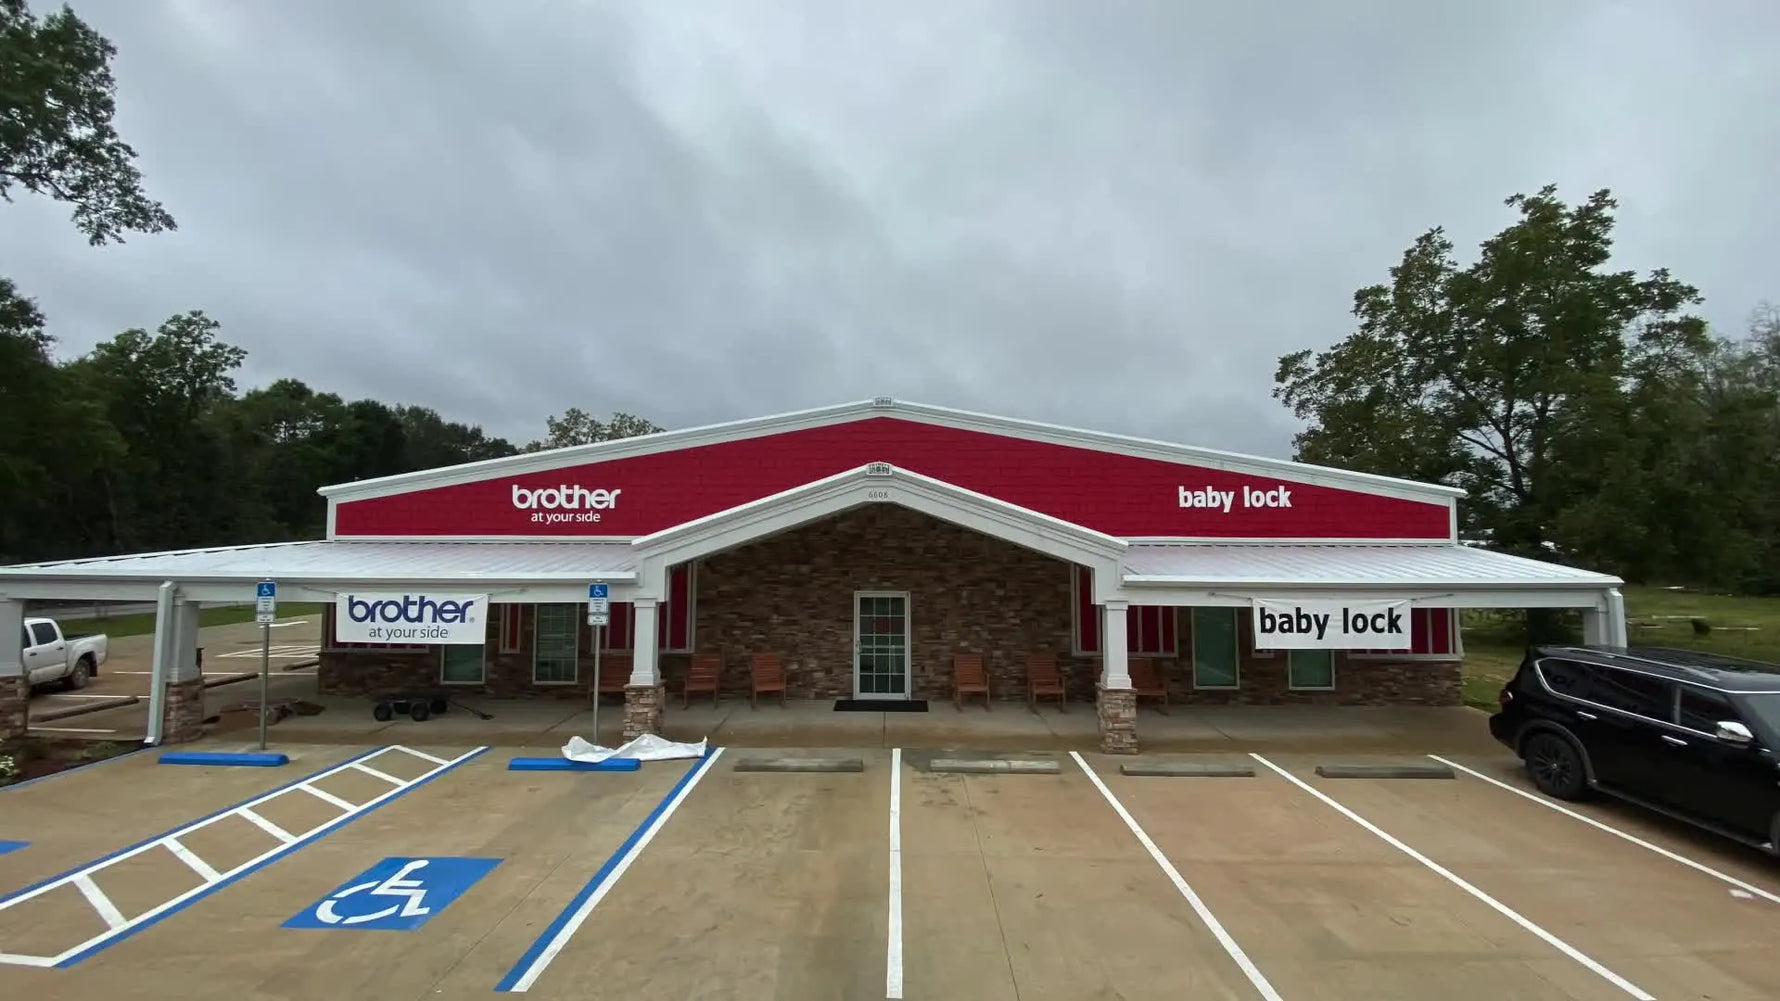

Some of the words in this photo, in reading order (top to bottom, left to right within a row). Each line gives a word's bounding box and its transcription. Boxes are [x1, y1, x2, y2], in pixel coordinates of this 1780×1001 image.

[512, 484, 621, 509] brother
[1178, 485, 1234, 513] baby
[1243, 485, 1292, 508] lock
[531, 512, 544, 522] at
[546, 512, 574, 525] your
[576, 510, 601, 522] side
[348, 595, 474, 623] brother
[368, 627, 382, 638] at
[385, 627, 417, 641] your
[420, 625, 449, 639] side
[1260, 607, 1330, 640] baby
[1343, 607, 1403, 634] lock
